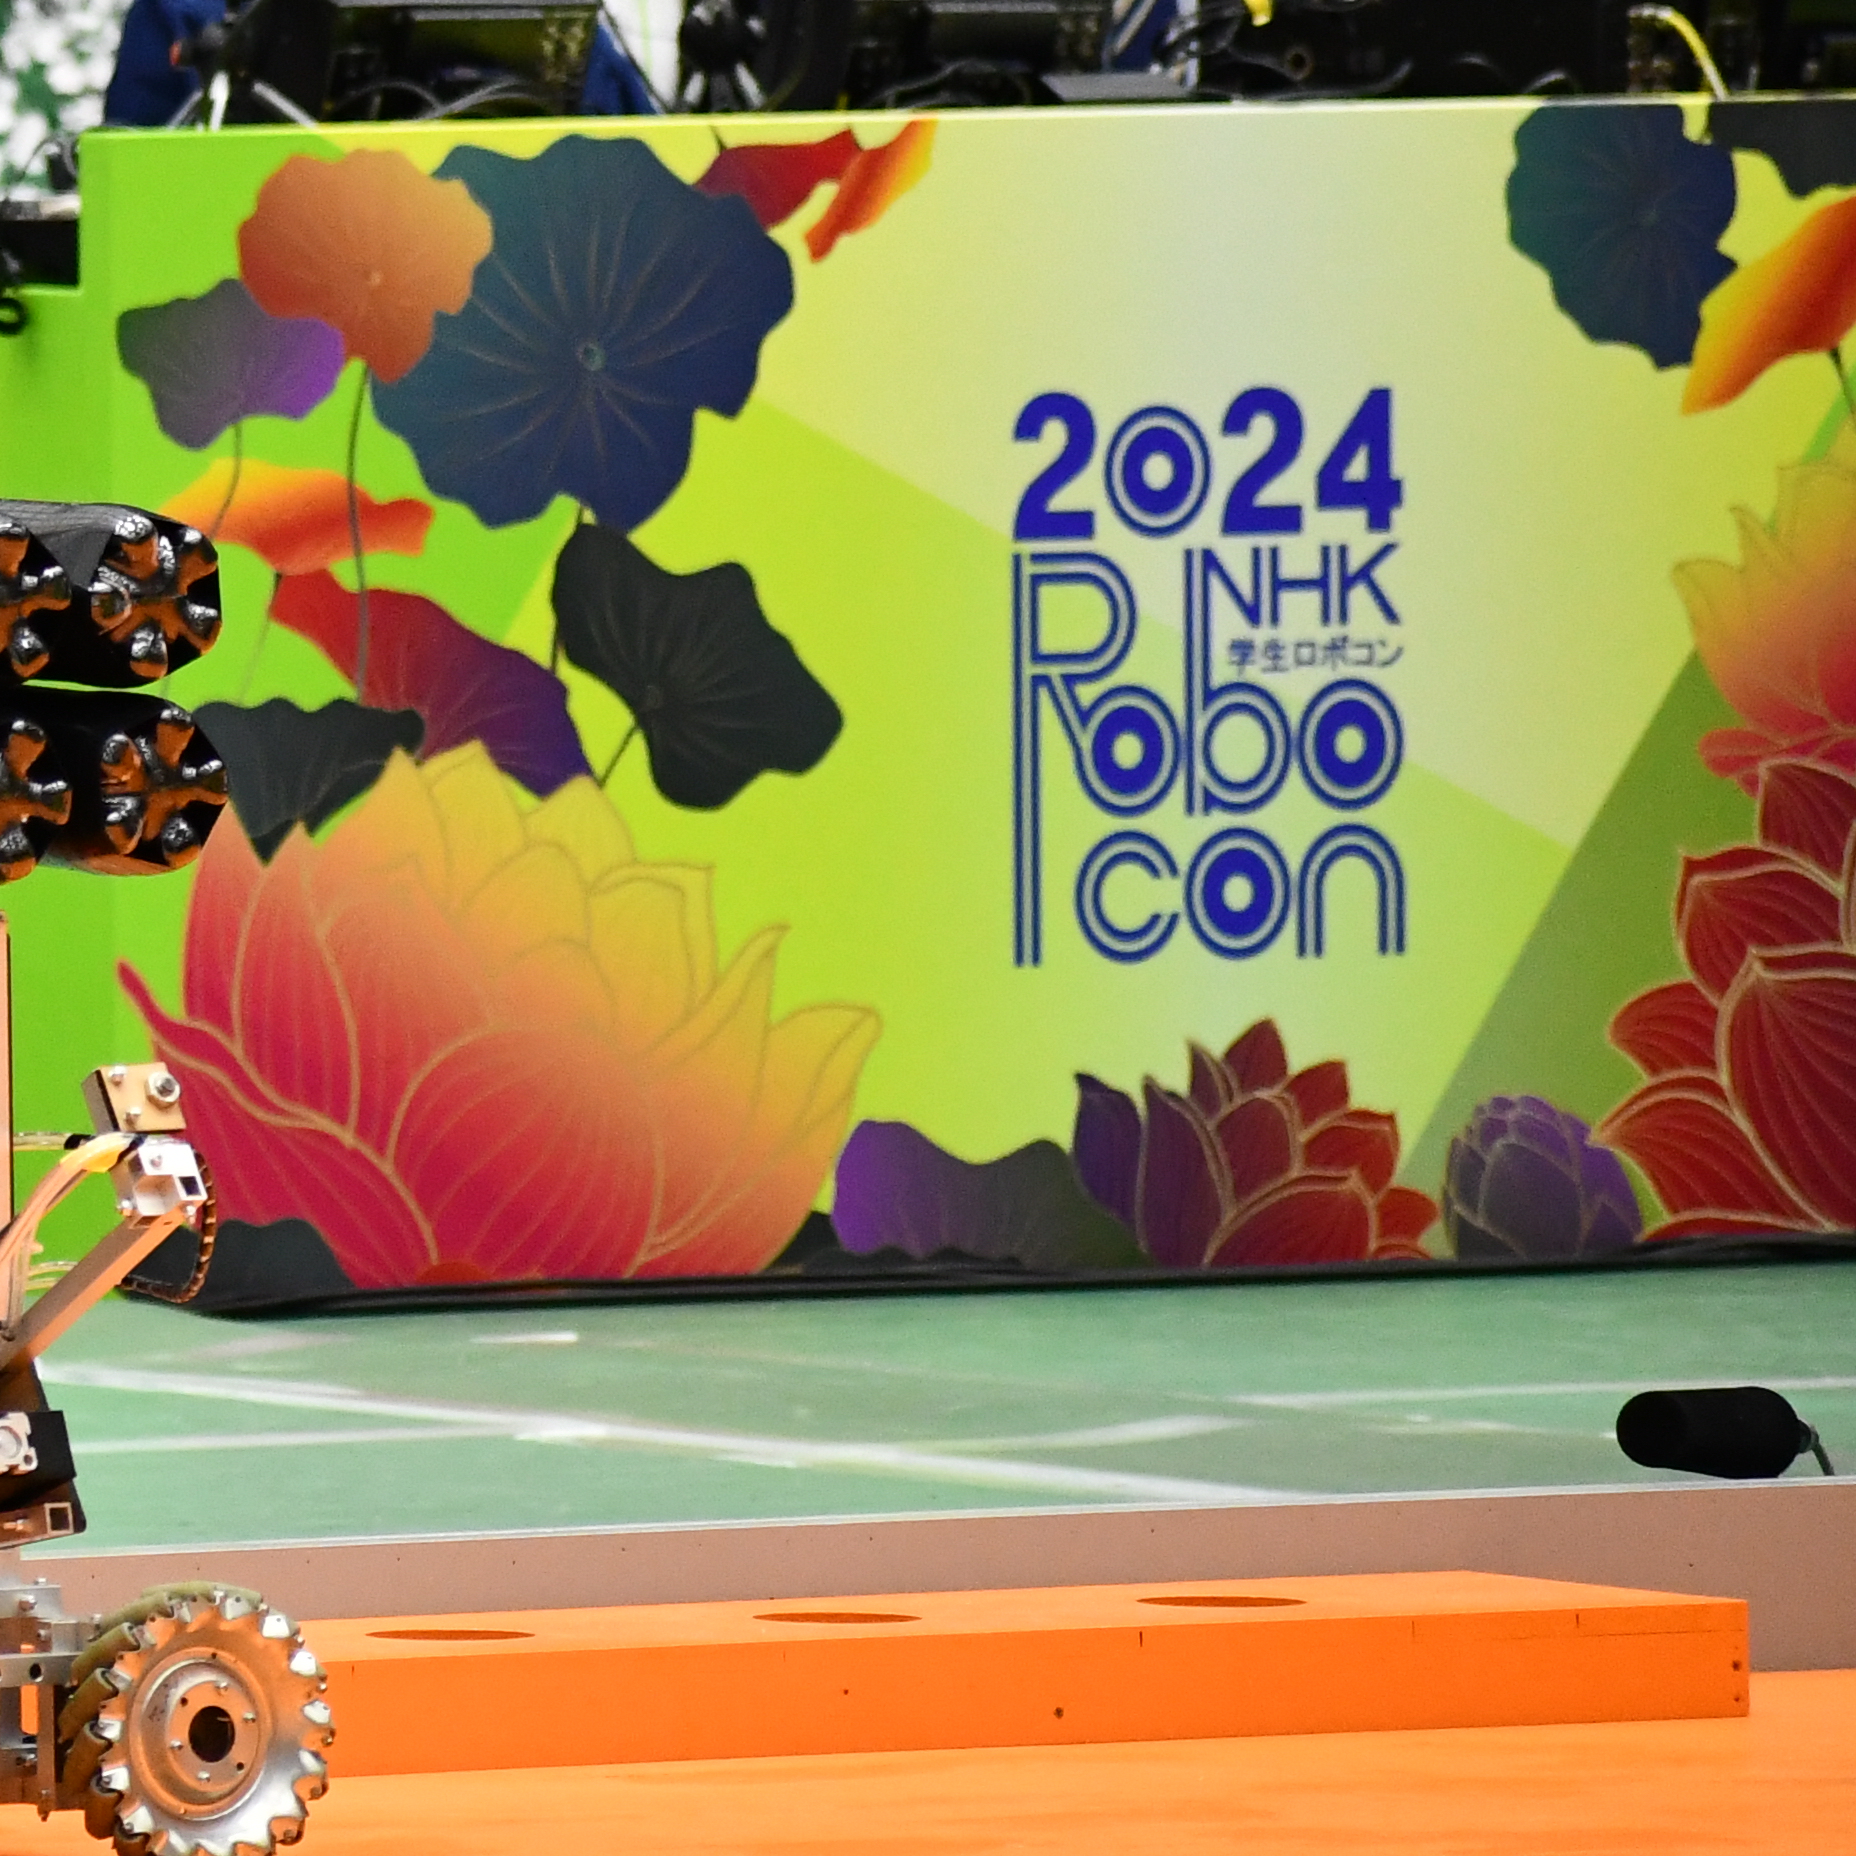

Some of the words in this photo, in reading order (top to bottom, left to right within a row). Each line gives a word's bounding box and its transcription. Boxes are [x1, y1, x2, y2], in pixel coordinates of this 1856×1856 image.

[1013, 386, 1404, 542] 2024
[1202, 543, 1401, 628] NHK
[1227, 635, 1404, 675] 学生ロボコン
